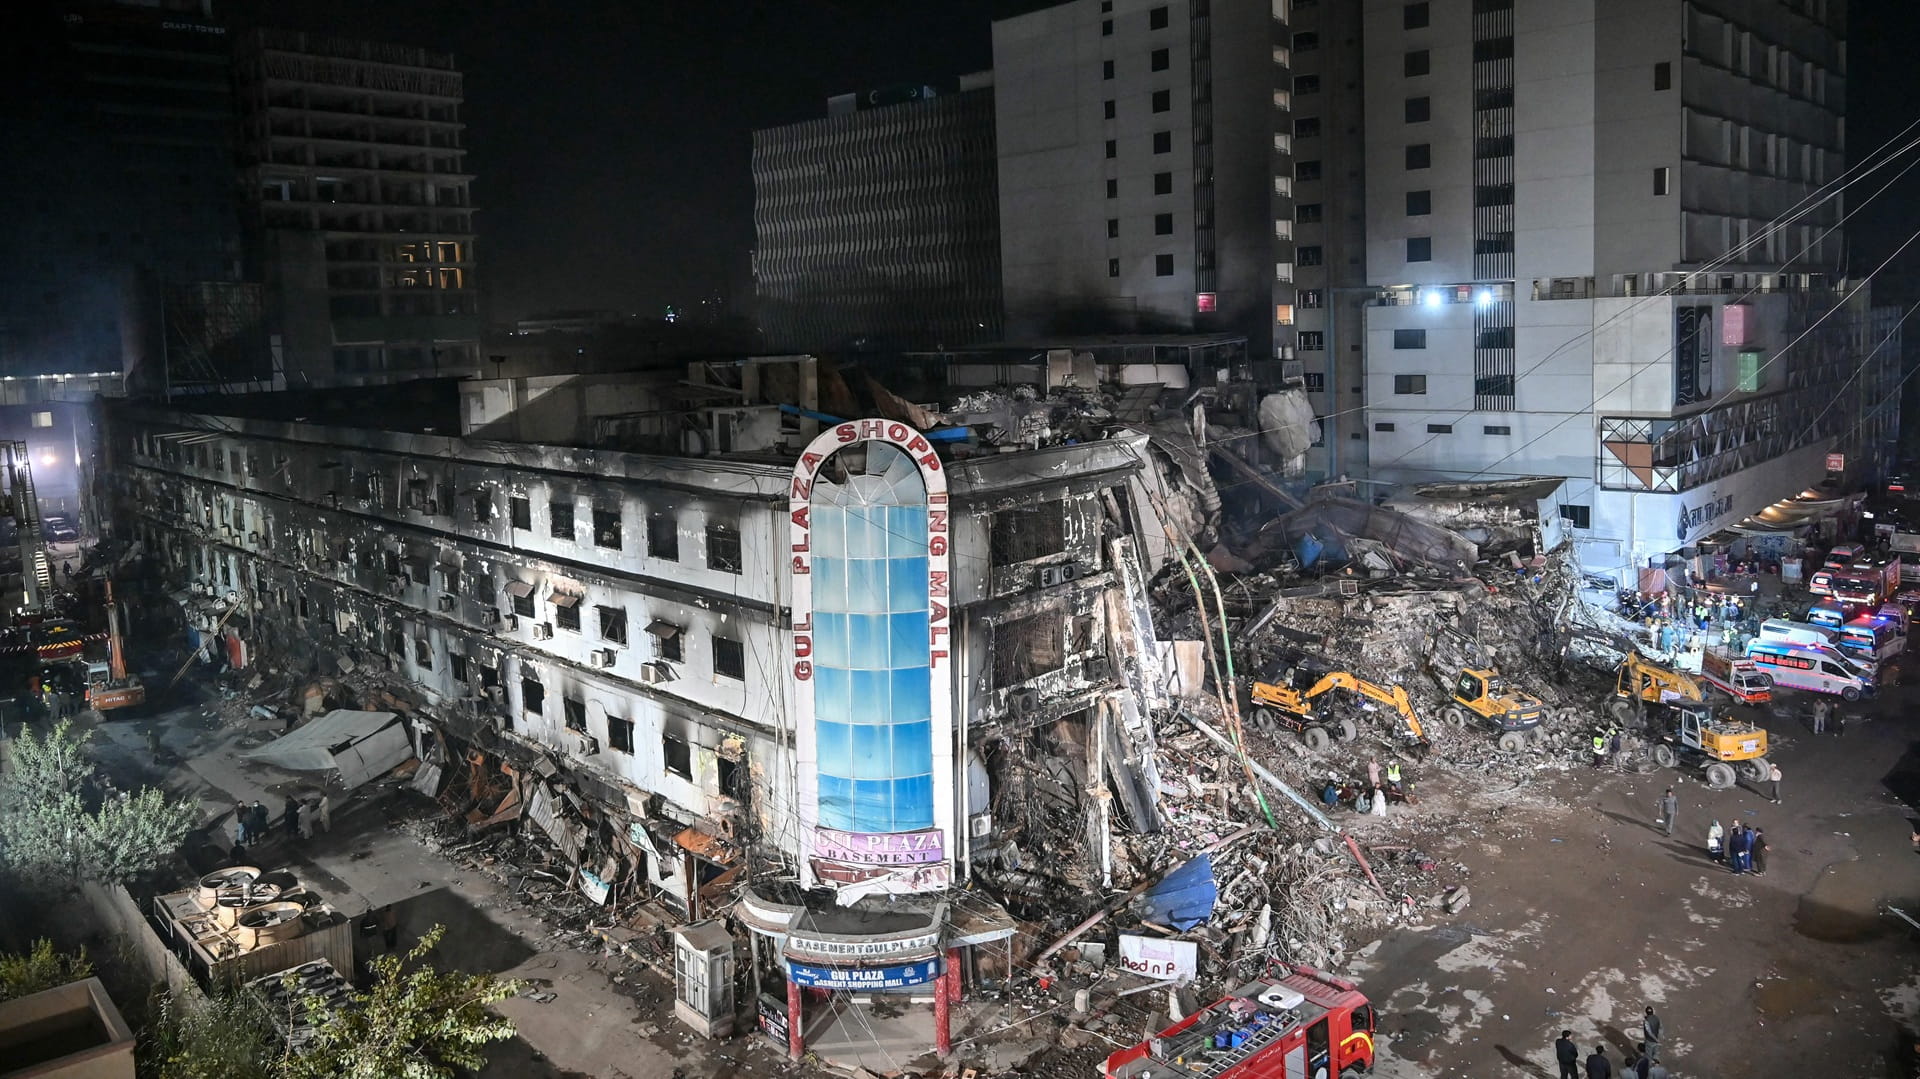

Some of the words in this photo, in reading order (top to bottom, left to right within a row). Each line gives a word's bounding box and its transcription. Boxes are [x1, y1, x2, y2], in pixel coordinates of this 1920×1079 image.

[791, 451, 824, 575] PLAZA
[929, 571, 949, 668] MALL
[794, 612, 813, 681] GUL
[816, 830, 859, 851] GUL
[866, 832, 942, 852] PLAZA
[828, 848, 930, 863] BASEMENT
[1121, 956, 1148, 972] Red
[1152, 964, 1160, 974] n
[831, 971, 851, 981] GUL
[852, 970, 885, 980] PLAZA
[848, 980, 884, 988] SHOPPING
[885, 978, 903, 987] MALL
